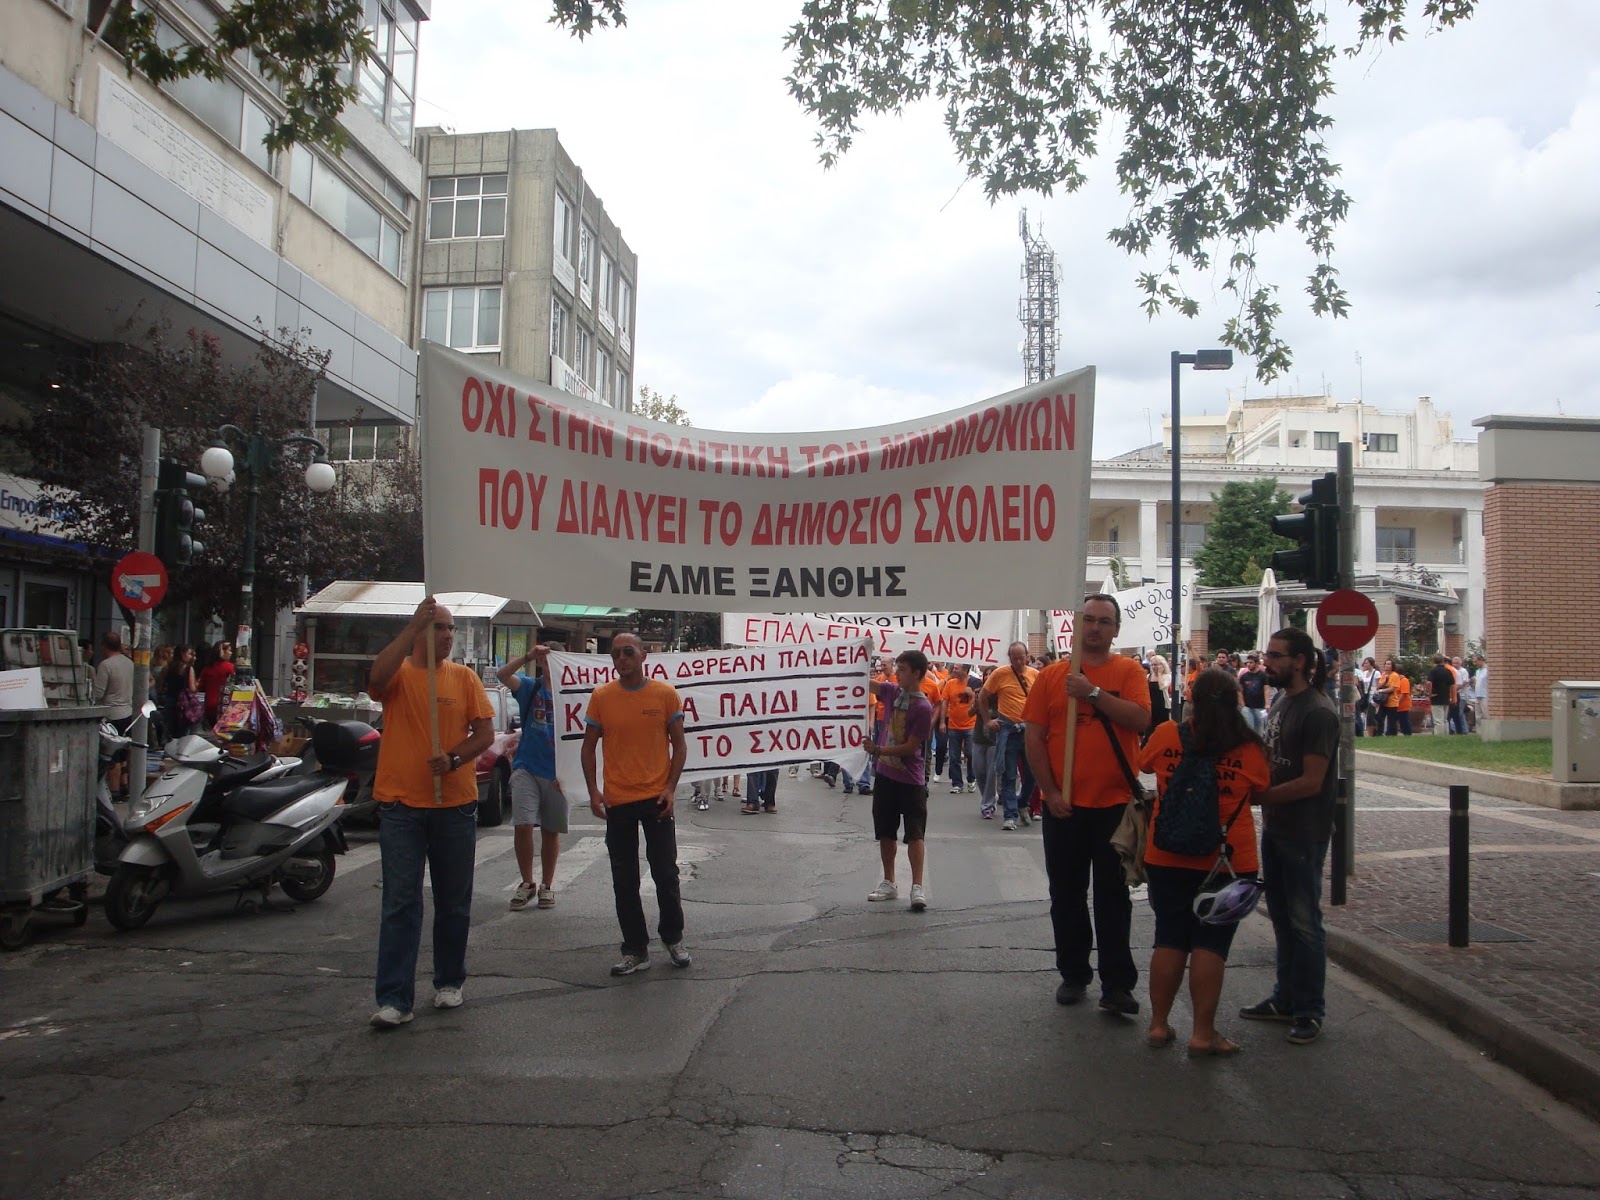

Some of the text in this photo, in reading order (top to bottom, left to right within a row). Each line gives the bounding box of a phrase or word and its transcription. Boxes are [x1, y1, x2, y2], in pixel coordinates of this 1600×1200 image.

[462, 377, 516, 438] ΟΧΙ
[527, 396, 613, 458] ΣΤΗΝ
[625, 427, 790, 479] ΠΟΛΙΤΙΚΗ
[800, 441, 870, 477] ΤΩΝ
[880, 394, 1075, 470] ΜΝΗΜΟΝΙΩΝ
[479, 468, 1056, 546] ΠΟΥ ΔΙΑΛΥΕΙ ΤΟ ΔΗΜΟΣΙΟ ΣΧΟΛΕΙΟ
[630, 561, 906, 597] ΕΛΜΕ ΞΑΝΘΗΣ
[1147, 585, 1188, 604] όλος
[1153, 606, 1169, 624] &
[905, 630, 1001, 664] ΞΑΝΘΗΣ
[561, 645, 869, 686] ΔΗΜΙΑ ΔΩΡΕΑΝ ΠΑΙΔΕΙΑ
[720, 690, 797, 717] ΠΑΙΔΙ
[816, 686, 866, 712] ΕΞΩ
[698, 724, 864, 757] ΤΟ ΣΧΟΛΕΙΟ
[1163, 748, 1242, 769] ΔΗΣΙΑ
